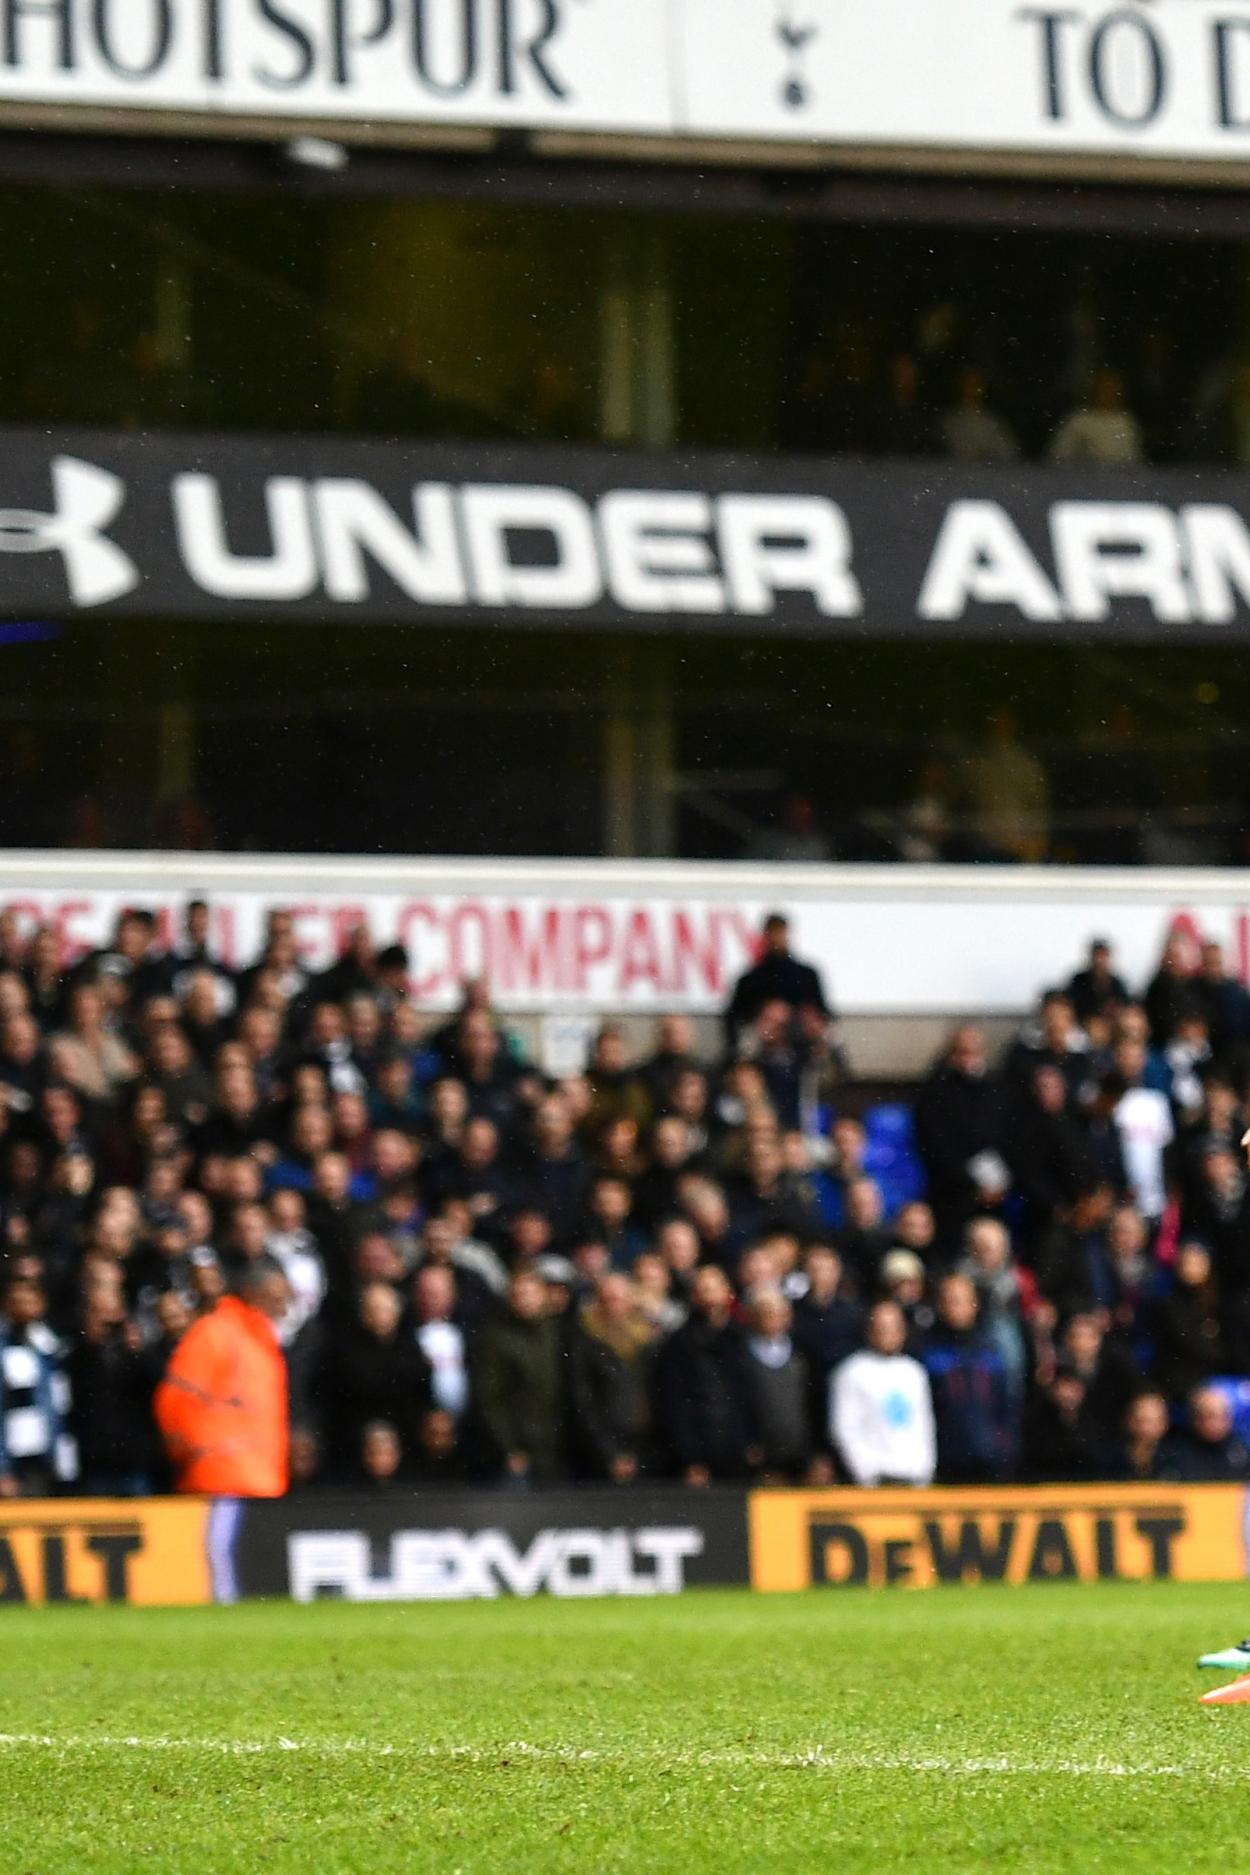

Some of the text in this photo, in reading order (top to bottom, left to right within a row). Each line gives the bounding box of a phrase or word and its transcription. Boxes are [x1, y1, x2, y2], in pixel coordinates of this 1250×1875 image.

[0, 0, 572, 103] HOTSPUR
[1014, 8, 1168, 130] TO
[172, 472, 864, 618] UNDER
[286, 1527, 704, 1603] FLEXVOLT
